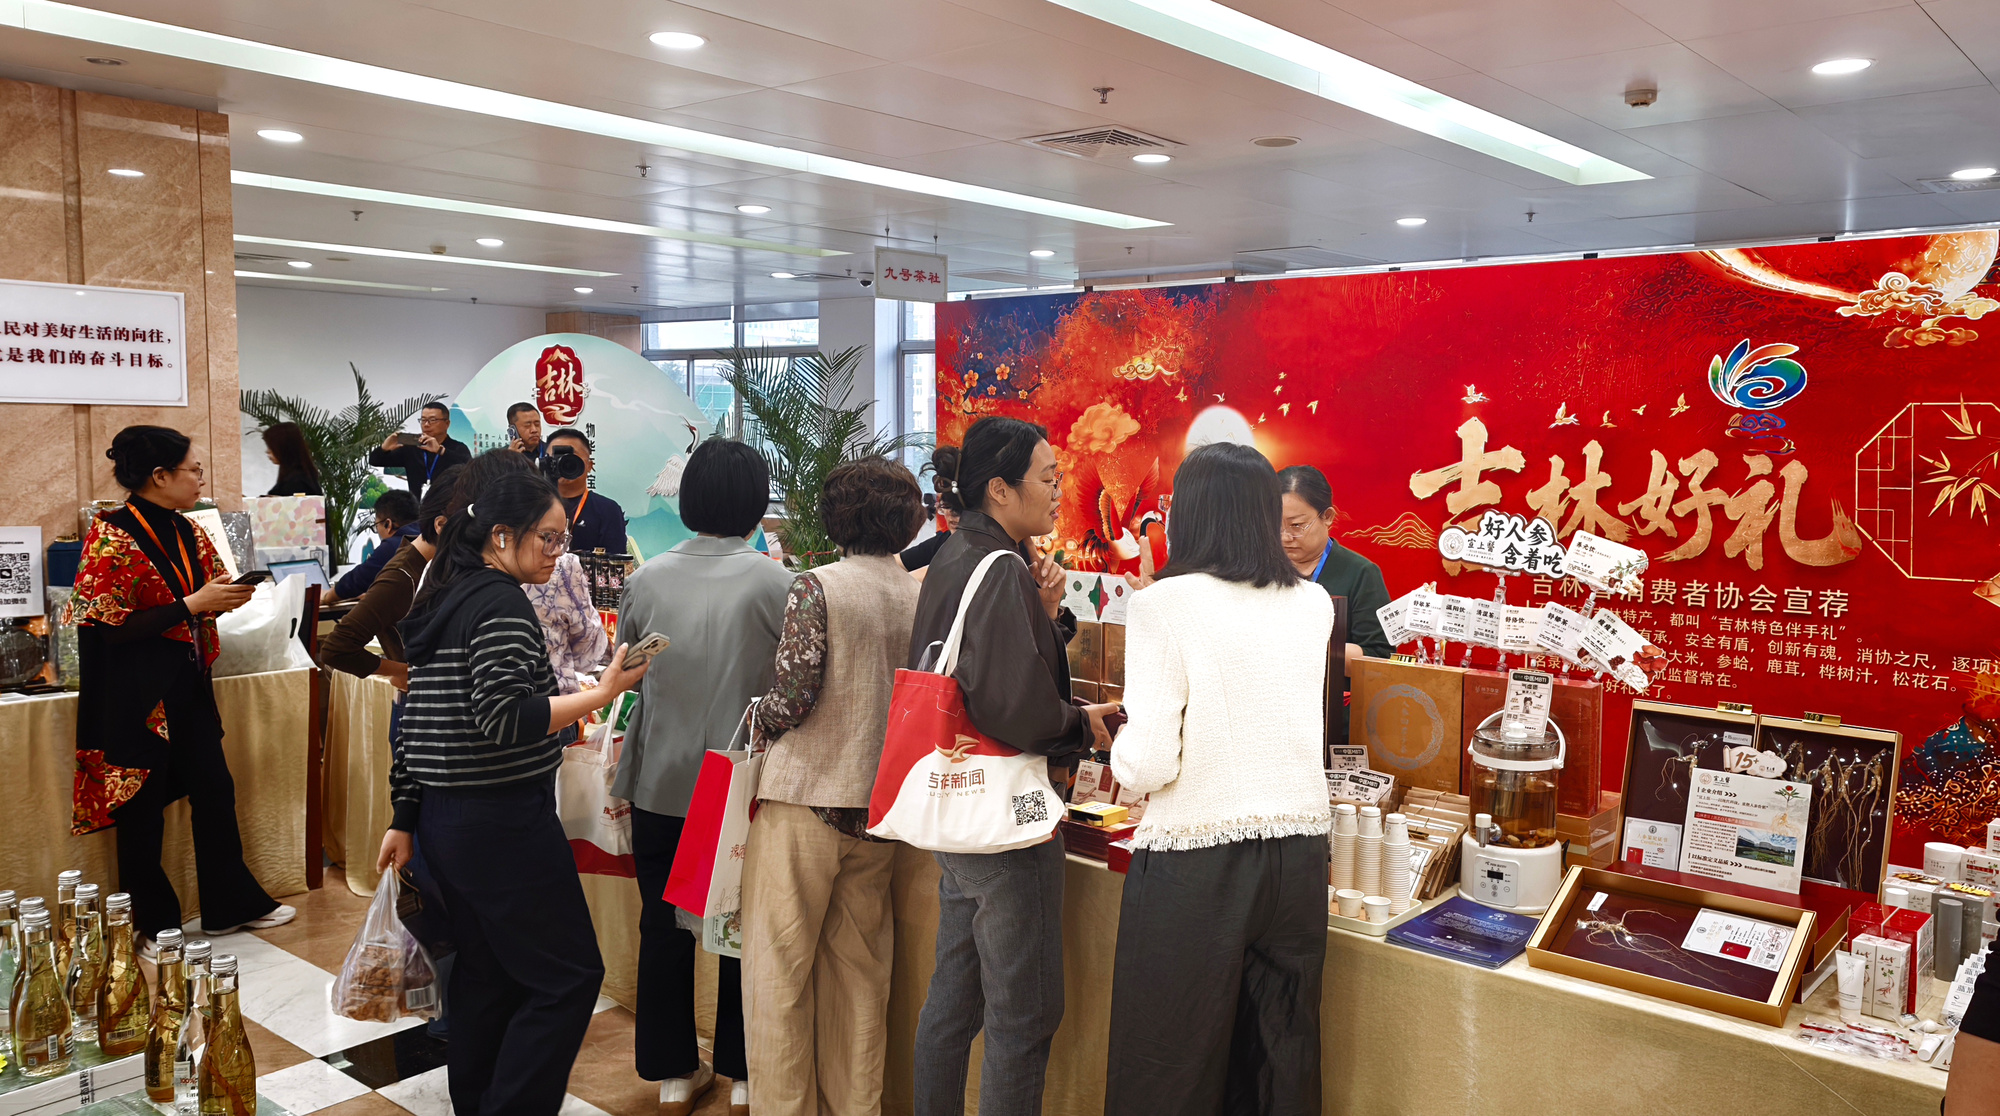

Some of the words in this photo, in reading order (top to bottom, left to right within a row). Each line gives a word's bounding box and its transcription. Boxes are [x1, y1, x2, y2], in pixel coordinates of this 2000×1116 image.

[884, 266, 941, 284] 九号茶社
[0, 347, 173, 369] 是我们的奋斗目标。
[540, 362, 582, 402] 吉林
[1408, 416, 1863, 577] 吉林好礼
[1482, 516, 1549, 547] 好人参
[1501, 542, 1565, 575] 含着吃
[1662, 649, 1957, 693] 大米，参蛤，鹿茸，桦树汁，松花石。
[957, 788, 986, 797] NEWS
